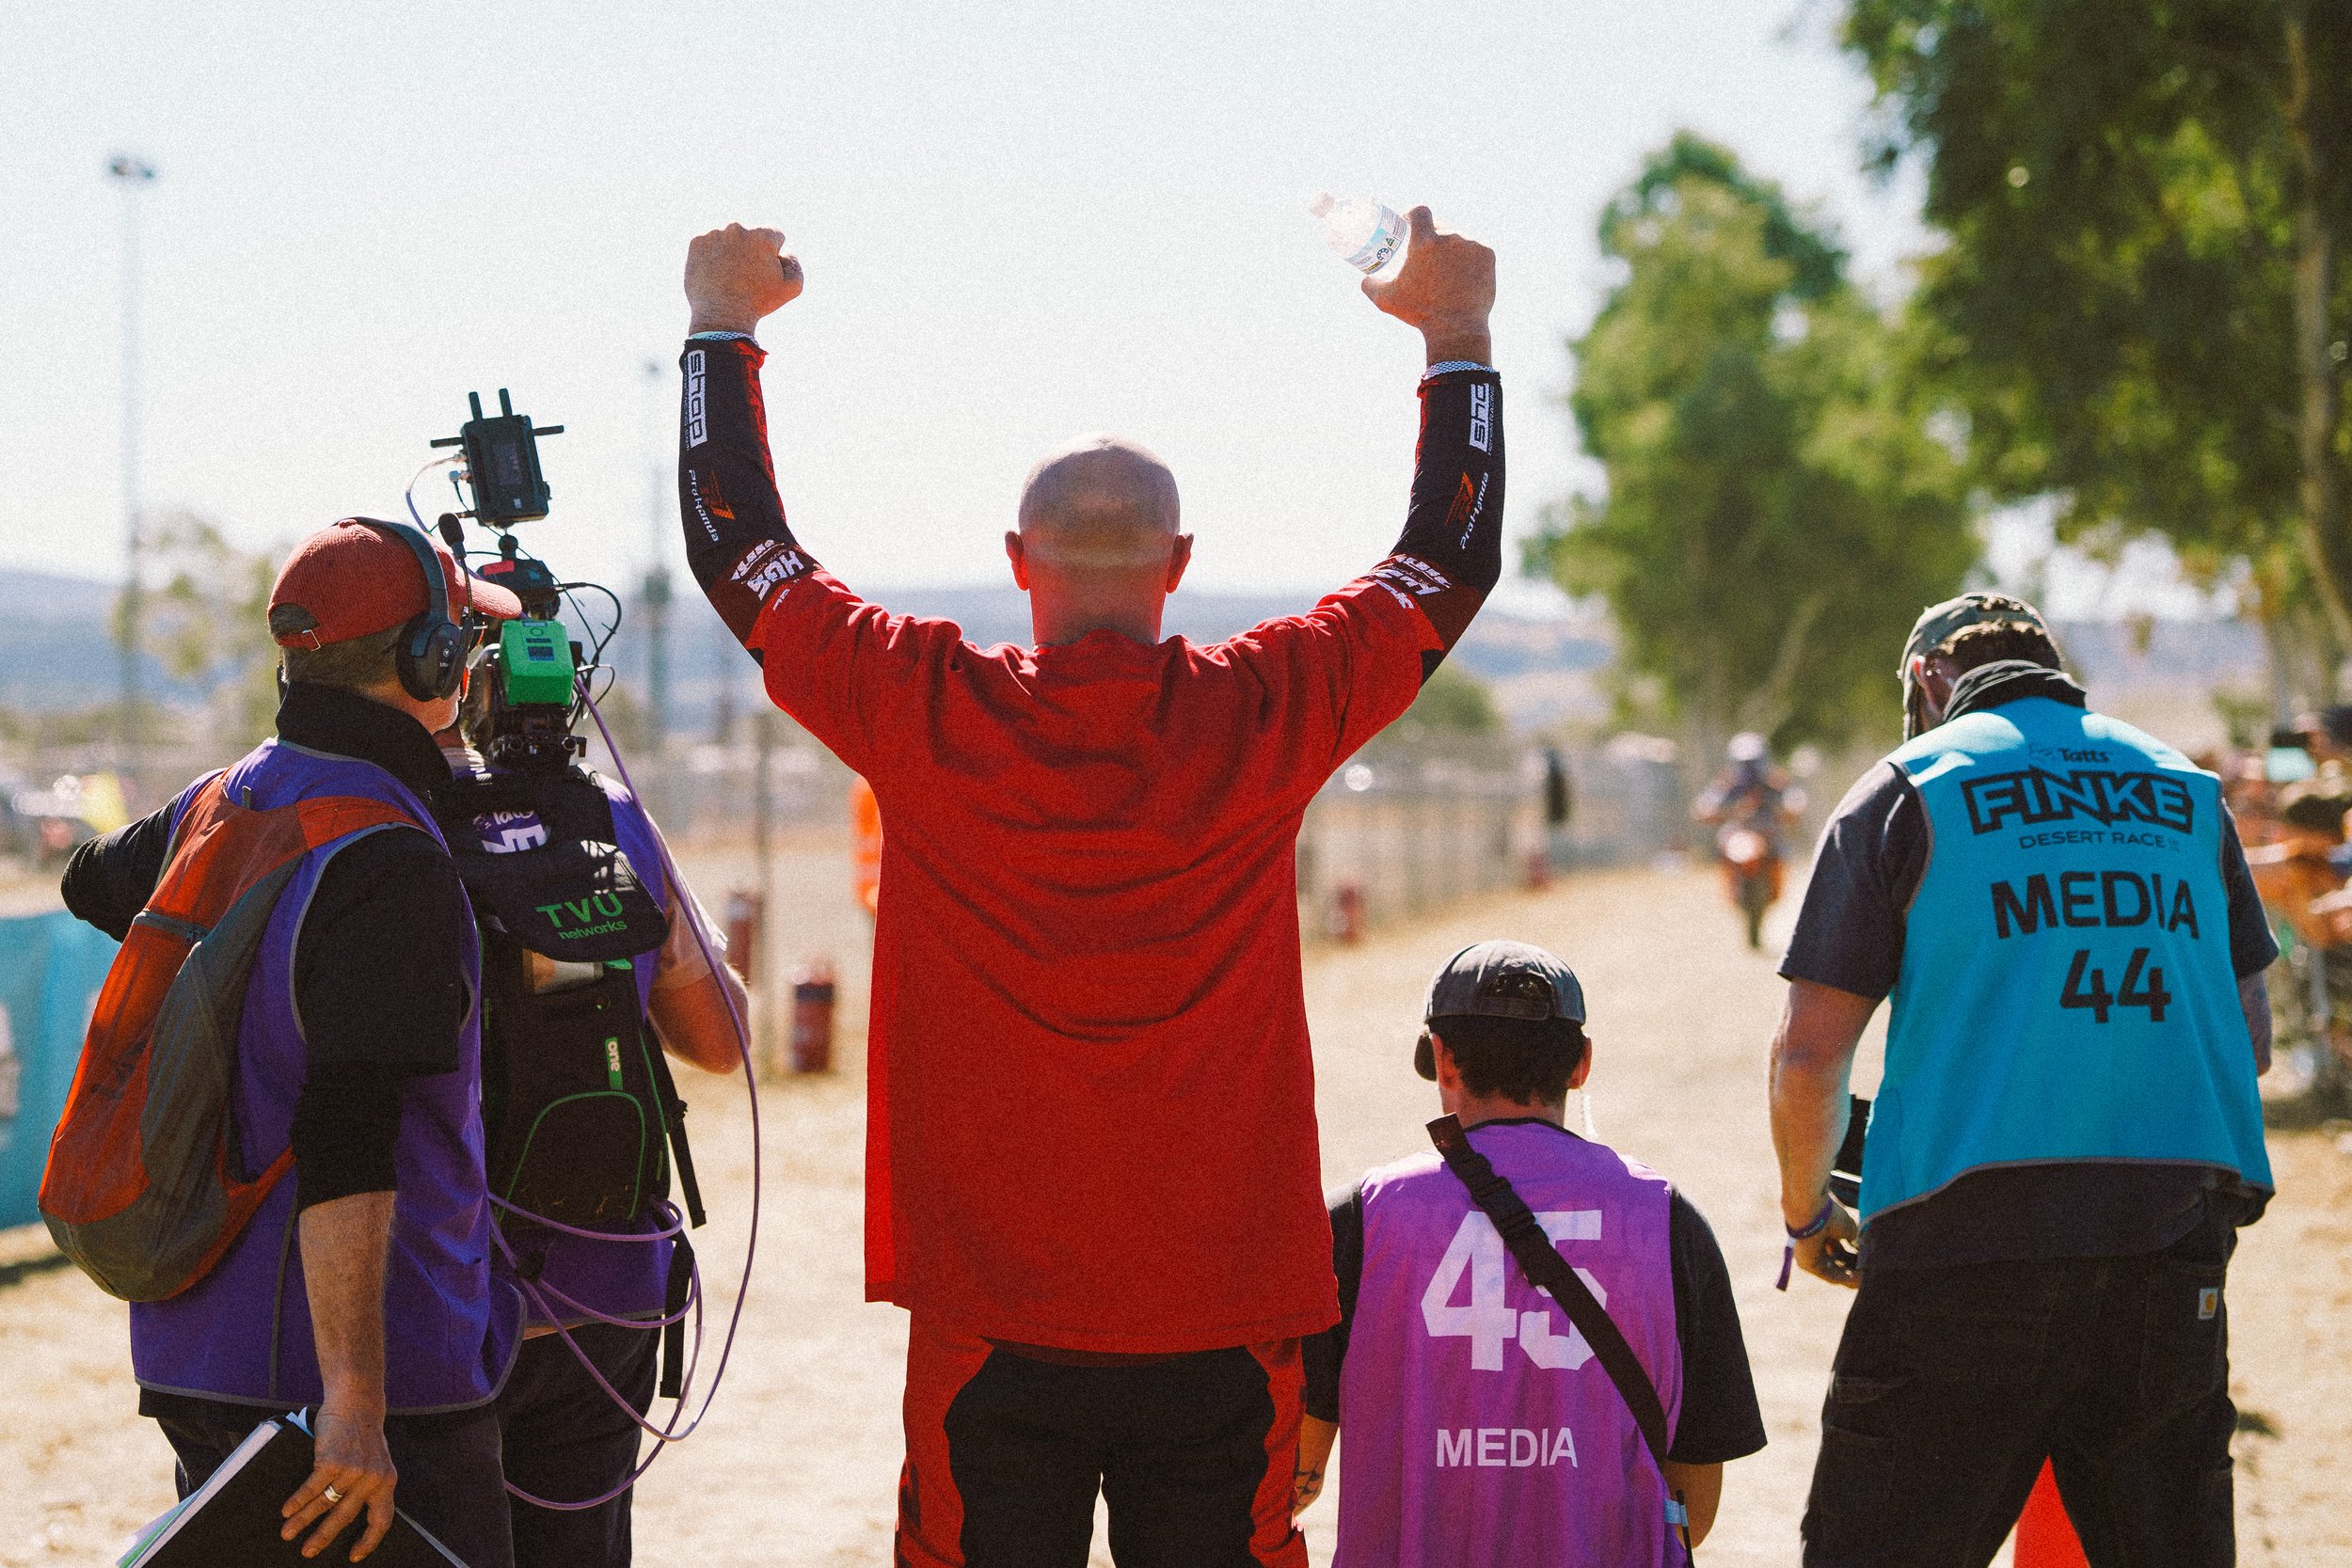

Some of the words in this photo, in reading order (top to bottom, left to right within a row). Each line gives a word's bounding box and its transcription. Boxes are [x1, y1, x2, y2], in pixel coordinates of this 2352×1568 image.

[1960, 765, 2194, 835] FINKE
[2019, 831, 2106, 849] DESERT
[2111, 832, 2165, 847] RACE
[534, 893, 623, 928] TVU
[1991, 871, 2200, 940] MEDIA
[559, 921, 628, 940] networks
[2059, 947, 2171, 1023] 44
[608, 1041, 621, 1071] one
[1421, 1210, 1608, 1371] 45
[1437, 1427, 1578, 1467] MEDIA
